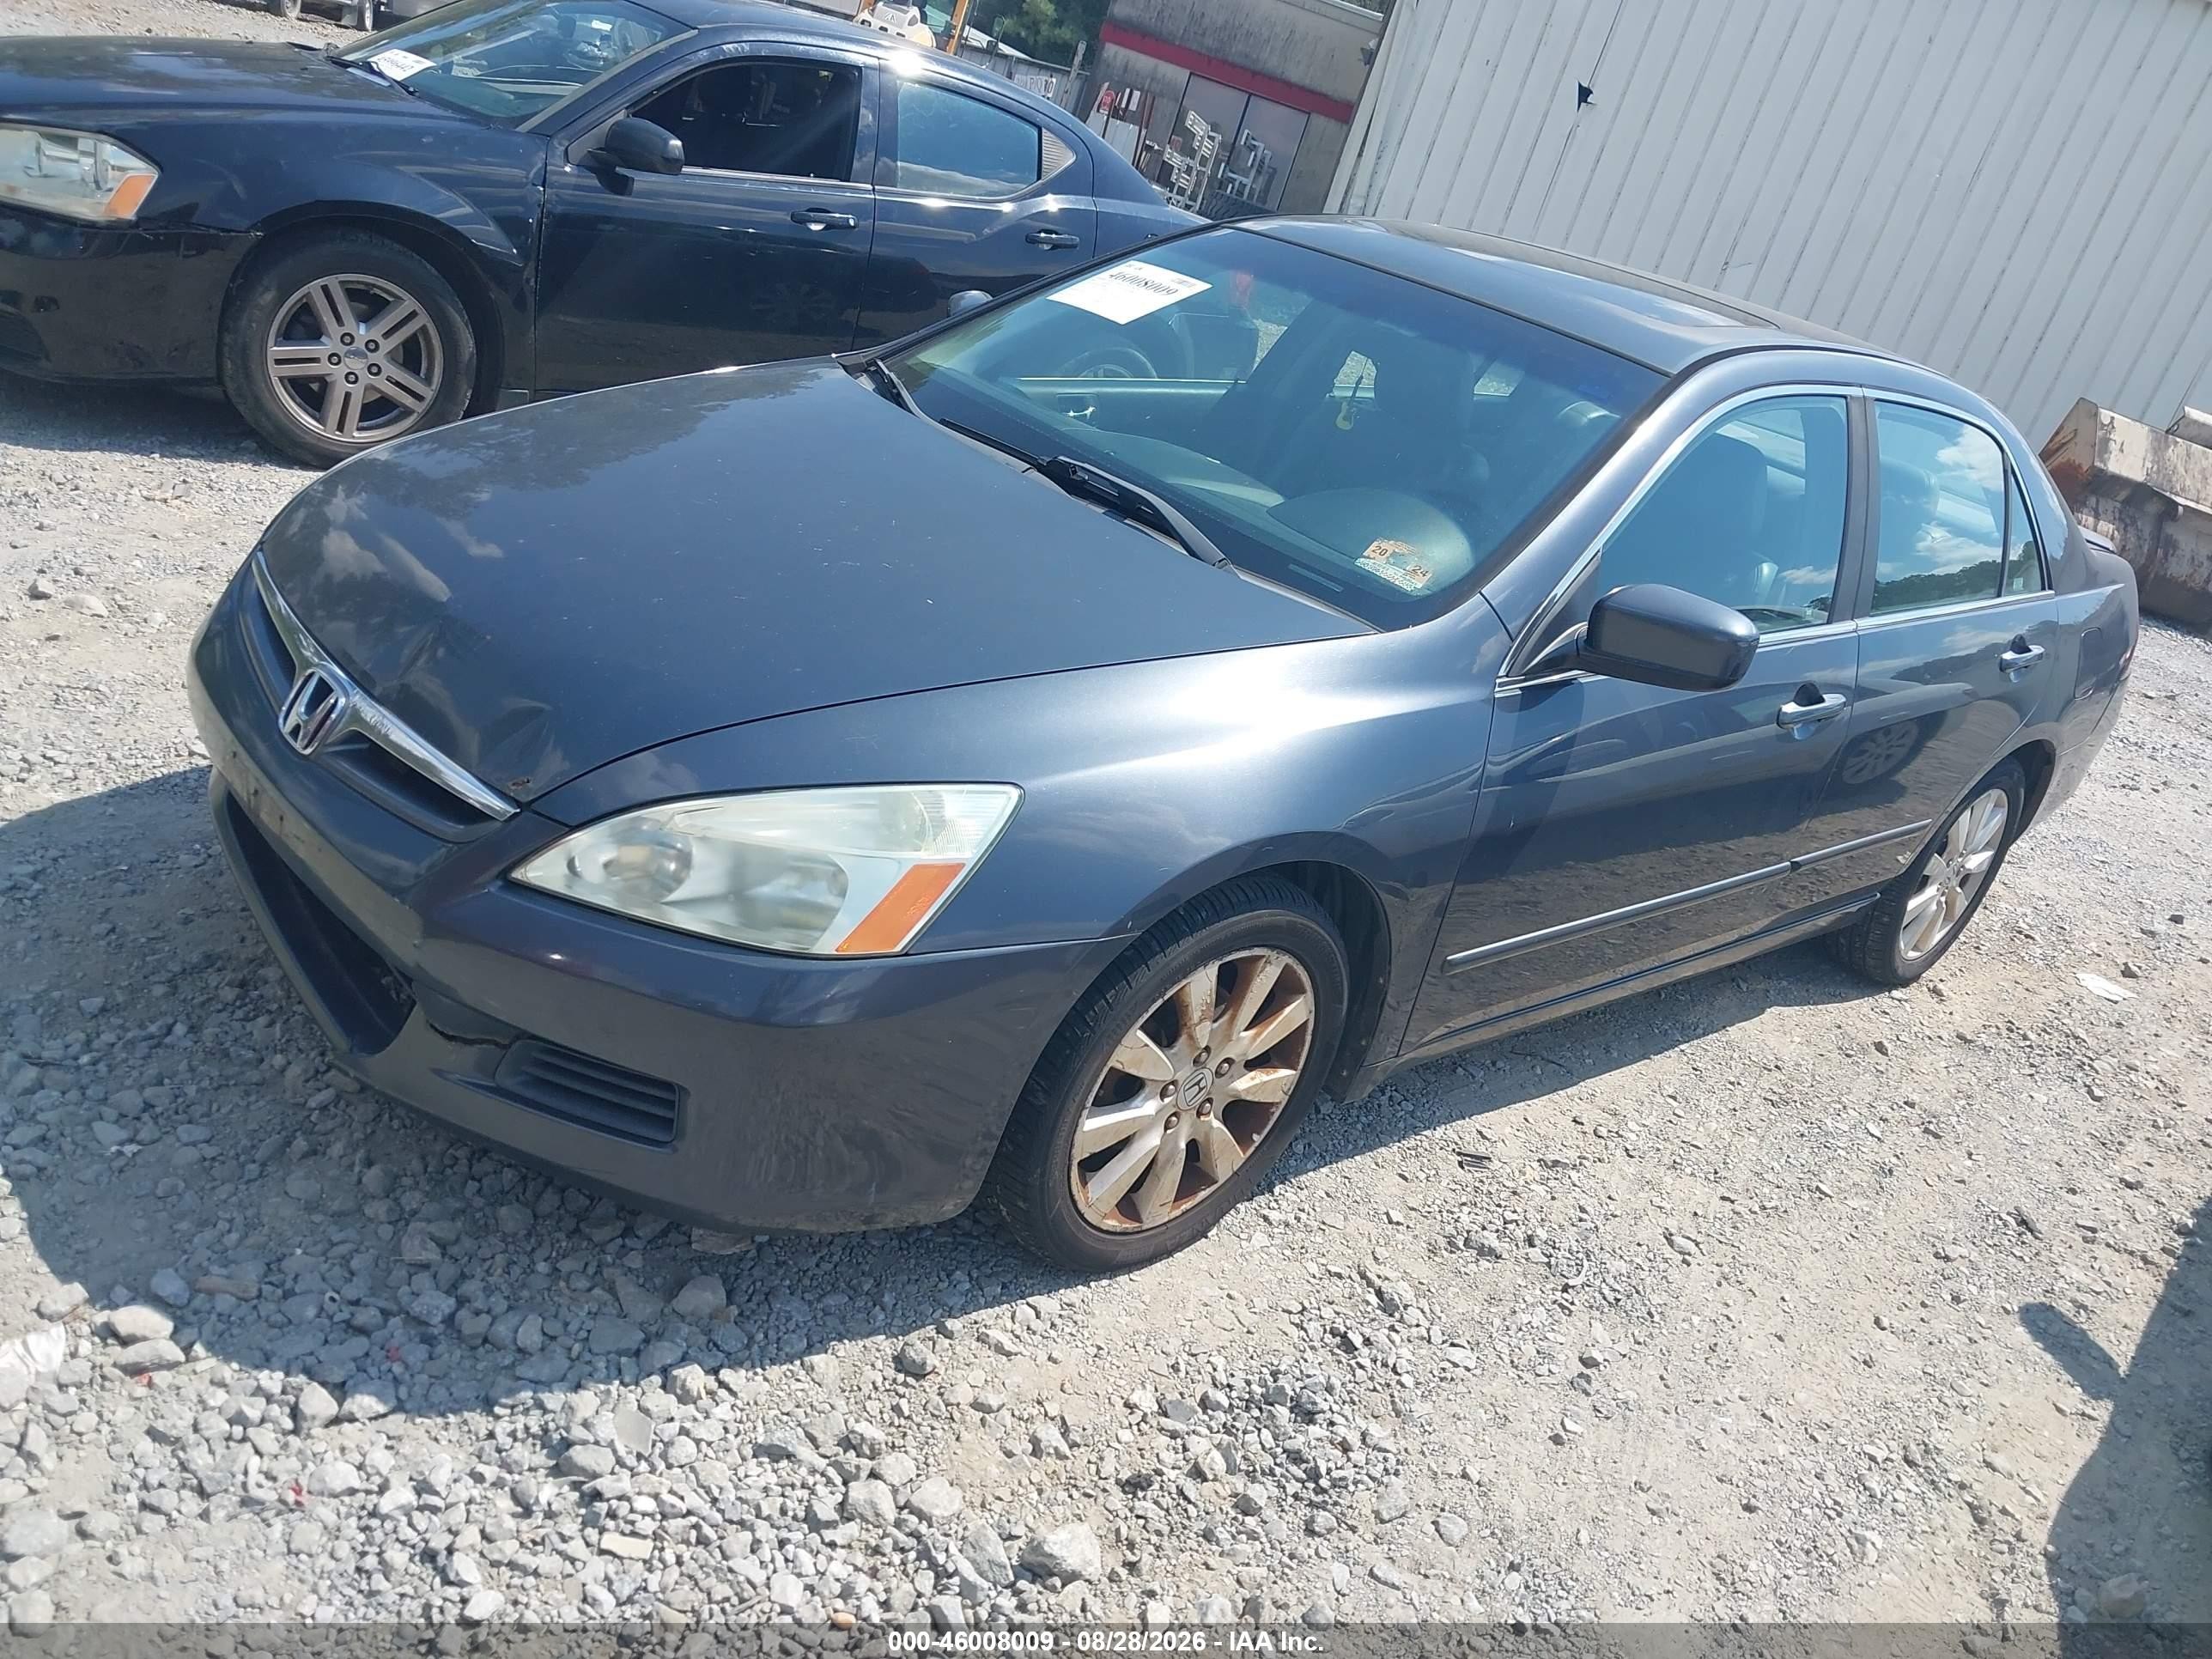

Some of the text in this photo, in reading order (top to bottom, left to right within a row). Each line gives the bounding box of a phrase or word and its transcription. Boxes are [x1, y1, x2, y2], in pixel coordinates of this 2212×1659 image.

[1109, 271, 1179, 295] 46008009
[1371, 545, 1389, 556] 20
[1411, 565, 1429, 578] 24
